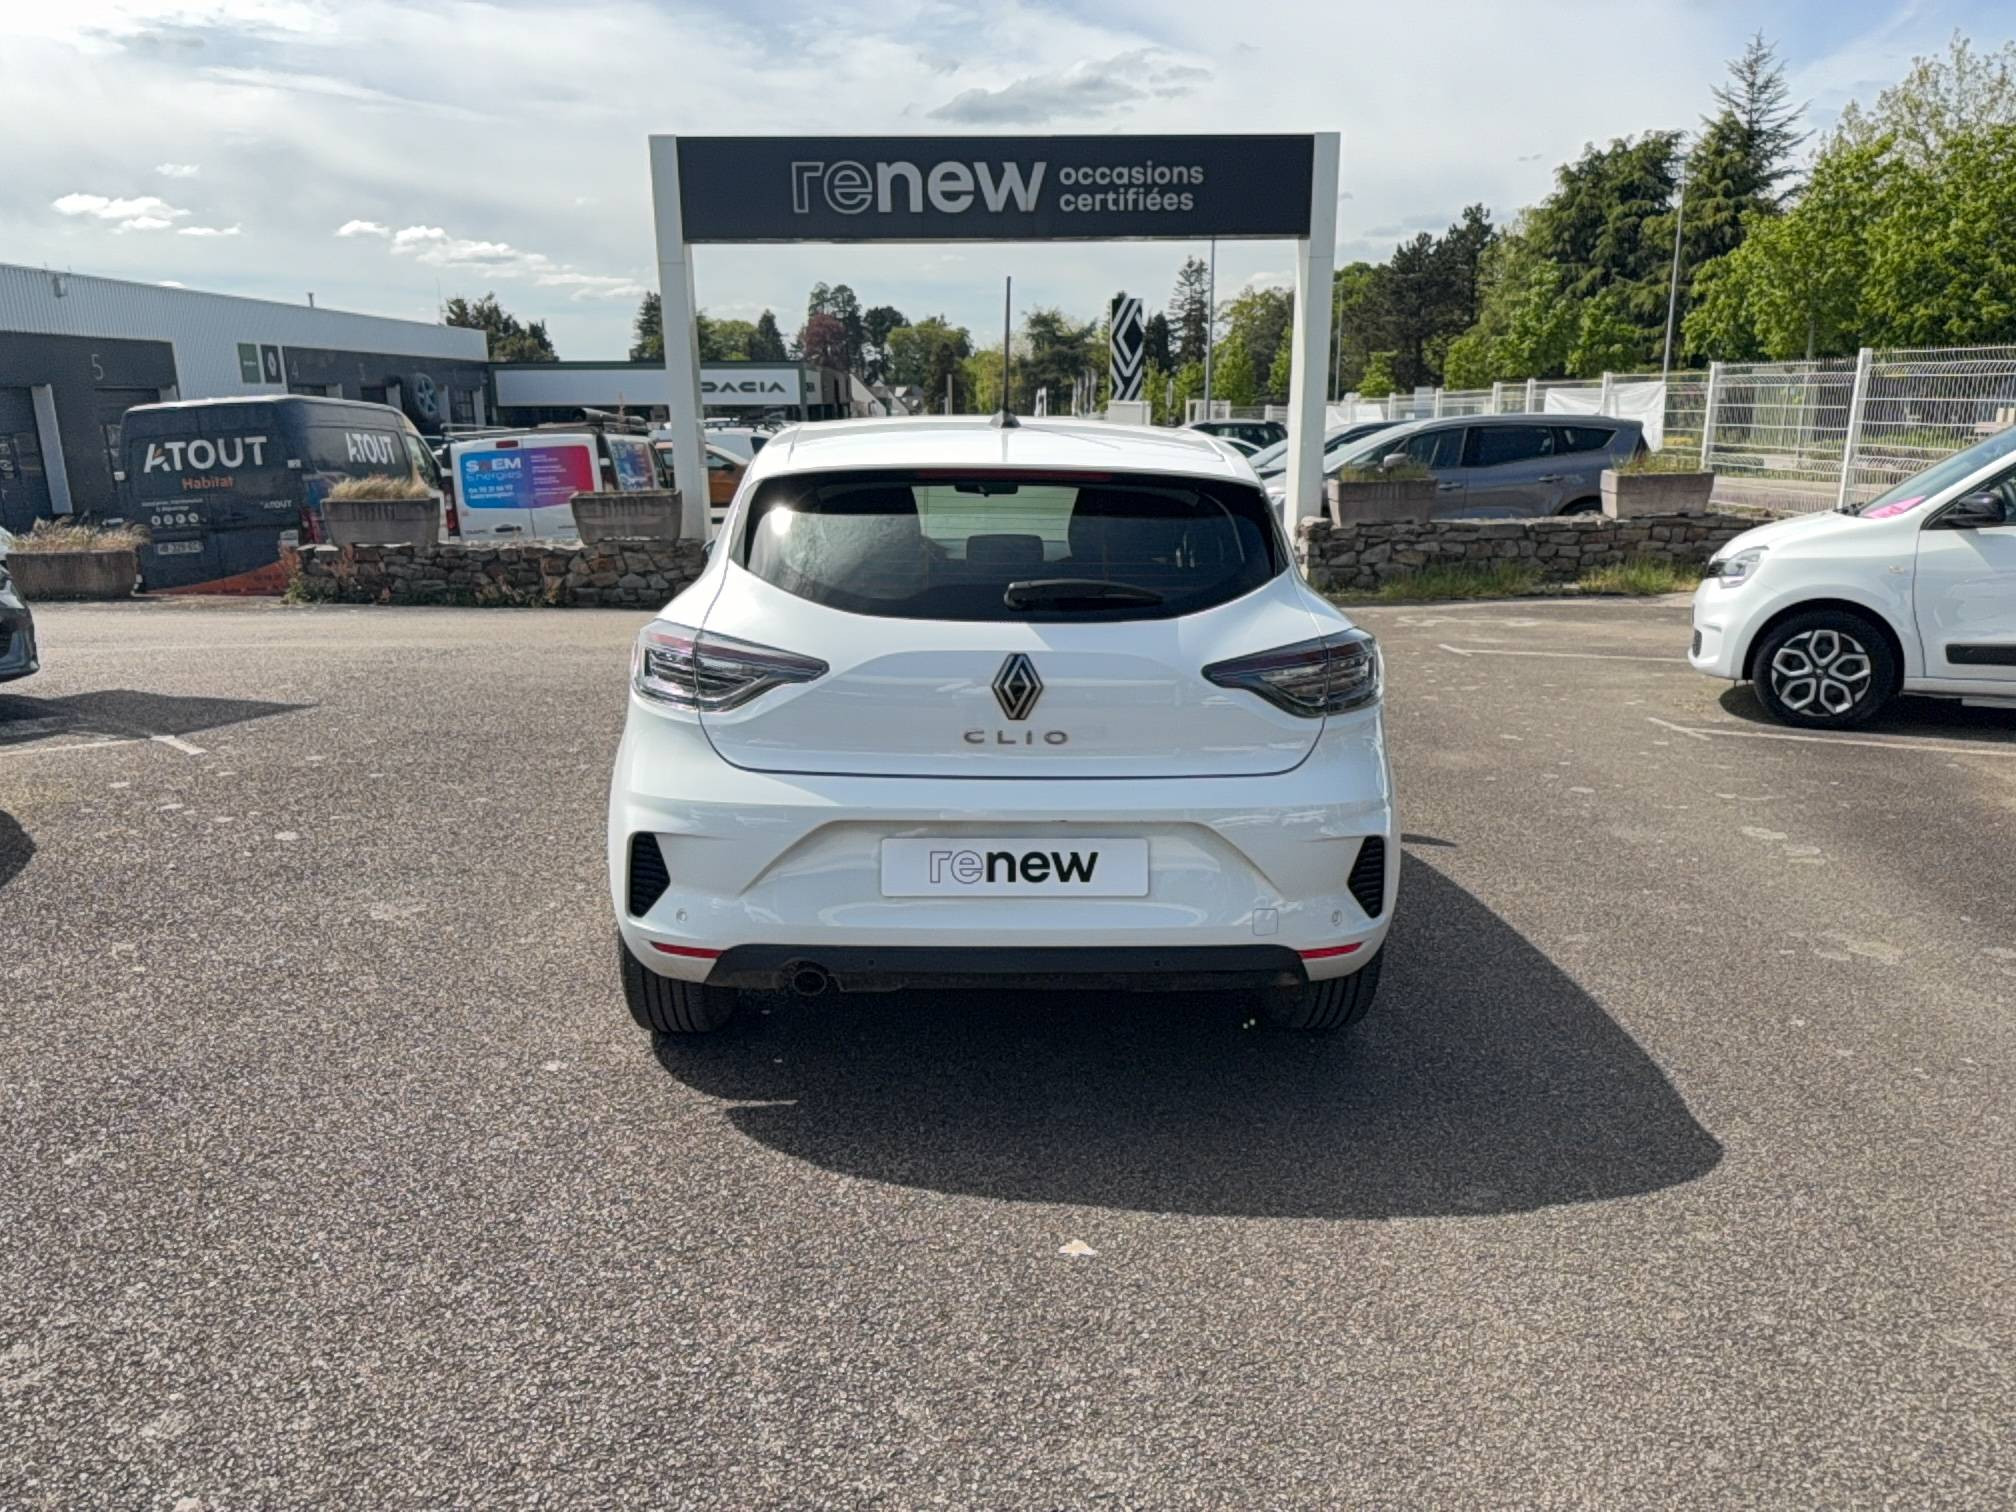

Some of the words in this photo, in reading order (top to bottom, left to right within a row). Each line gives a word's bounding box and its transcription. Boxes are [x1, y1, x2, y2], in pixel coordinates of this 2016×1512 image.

[1059, 161, 1204, 185] occasions
[791, 160, 1047, 214] renew
[1059, 187, 1194, 212] certifiées
[91, 354, 104, 380] 5
[701, 382, 786, 393] DACIA
[143, 436, 268, 473] ATOUT
[345, 432, 396, 465] ATOUT
[181, 475, 235, 490] Habitat
[963, 729, 1068, 746] CLIO
[929, 849, 1099, 884] renew
